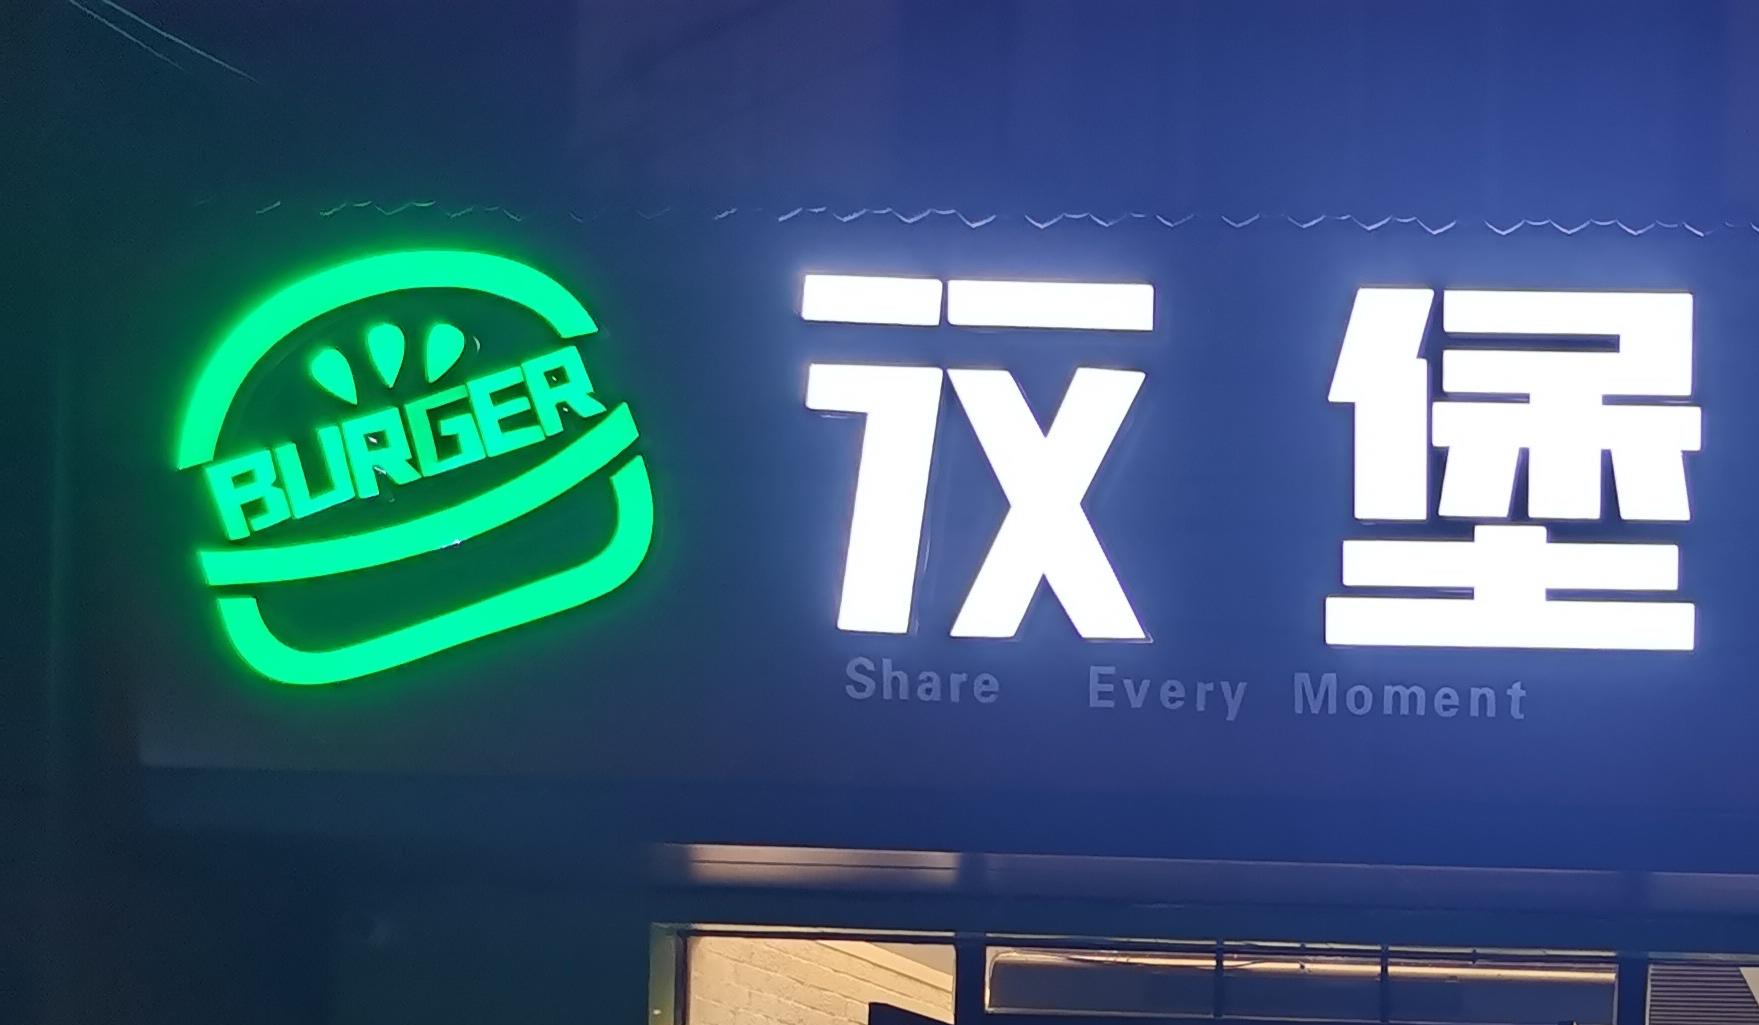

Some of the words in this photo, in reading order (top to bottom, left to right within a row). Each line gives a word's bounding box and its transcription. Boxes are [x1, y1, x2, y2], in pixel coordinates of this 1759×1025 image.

[205, 345, 606, 541] BURGER
[844, 657, 1000, 706] Share
[1088, 665, 1248, 721] Every
[1293, 672, 1527, 719] Moment
